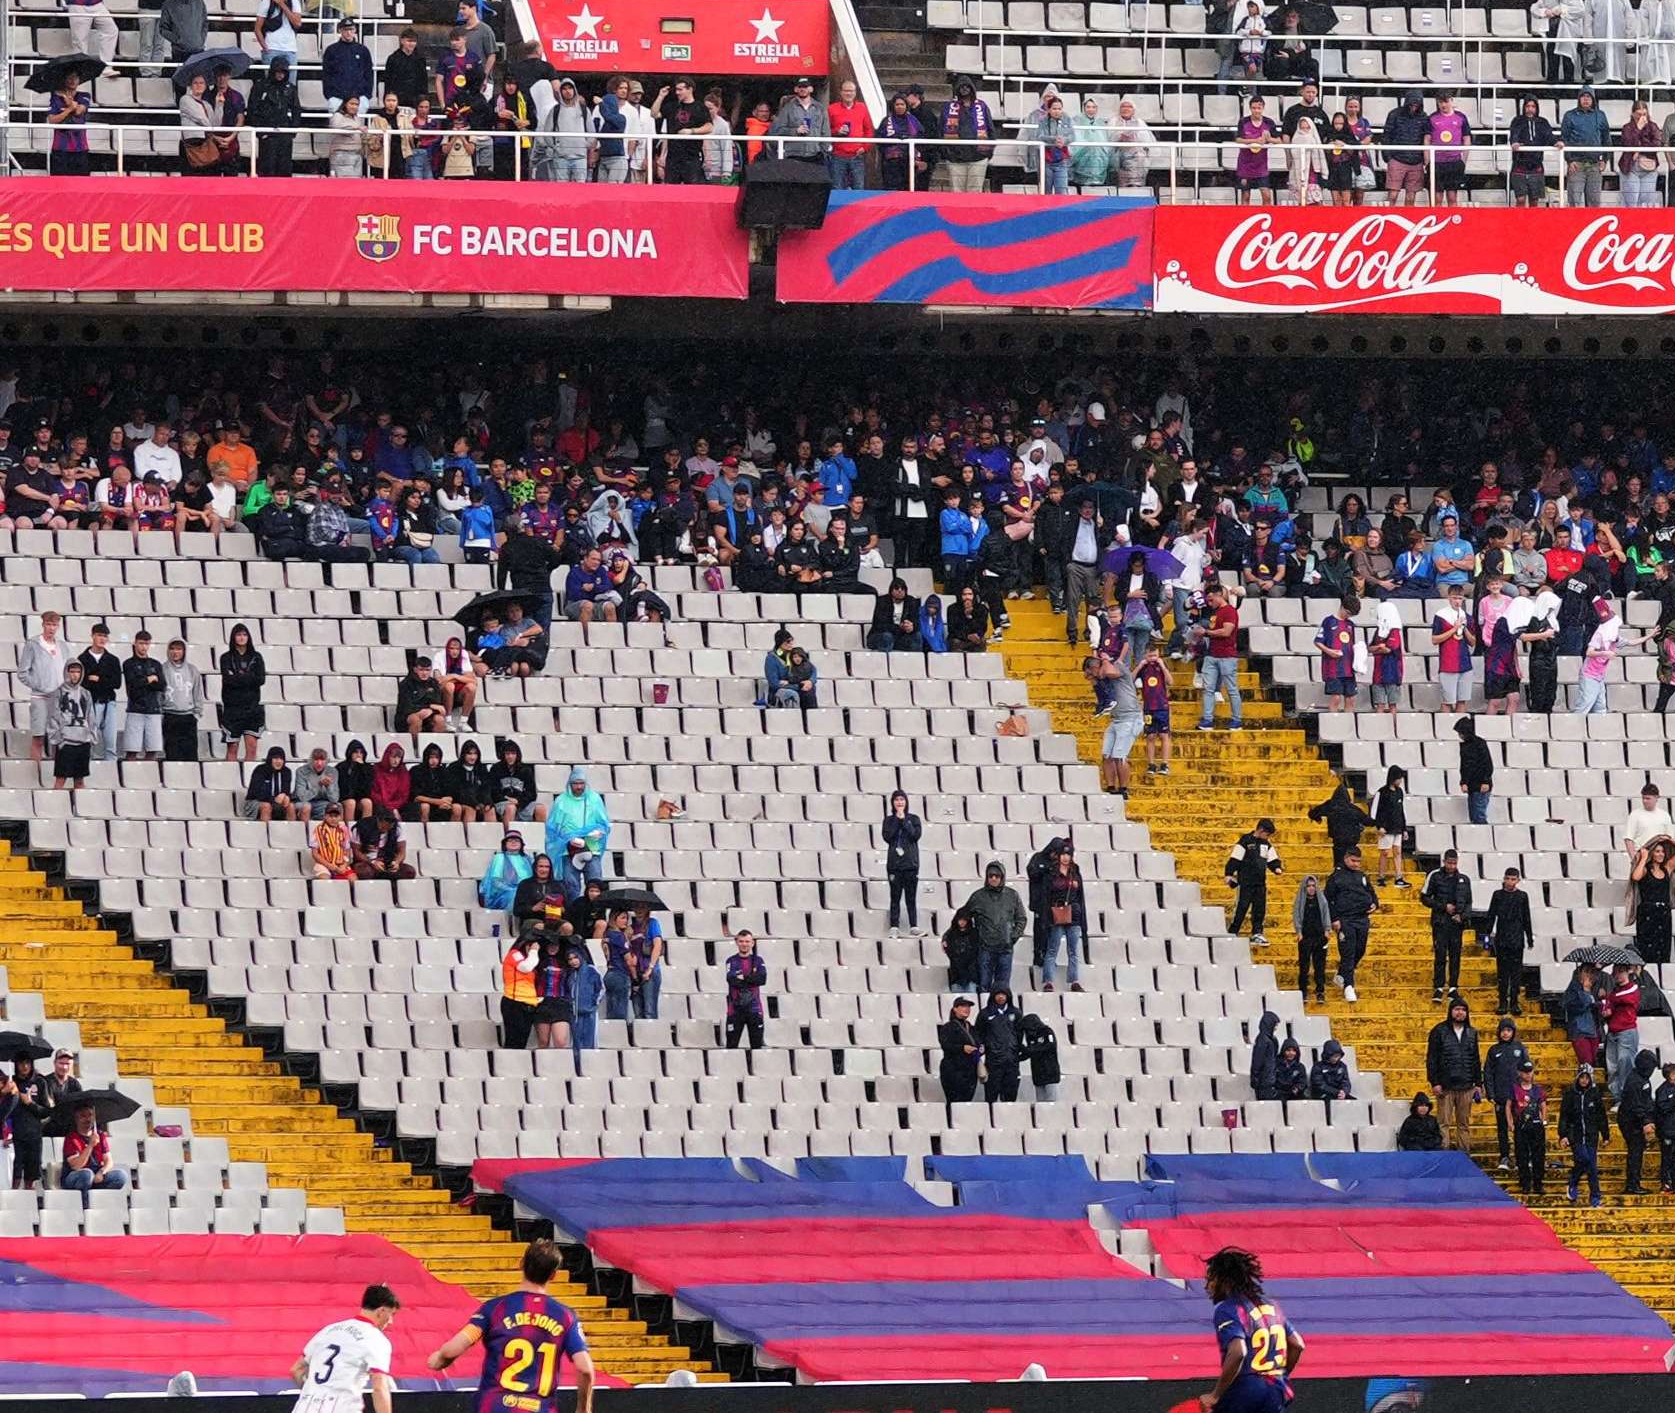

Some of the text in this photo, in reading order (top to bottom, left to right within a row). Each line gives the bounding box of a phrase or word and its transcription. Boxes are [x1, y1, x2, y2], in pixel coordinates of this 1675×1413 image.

[552, 38, 619, 53] ESTRELLA
[573, 52, 598, 60] DAMM
[734, 43, 800, 57] ESTRELLA
[755, 56, 779, 64] DAMM
[42, 222, 112, 255] QUE
[120, 223, 171, 252] UN
[177, 223, 265, 253] CLUB
[413, 224, 658, 259] FC BARCELONA
[1215, 212, 1452, 291] Coca-Cola
[314, 1343, 341, 1385] 3
[498, 1337, 557, 1398] 21
